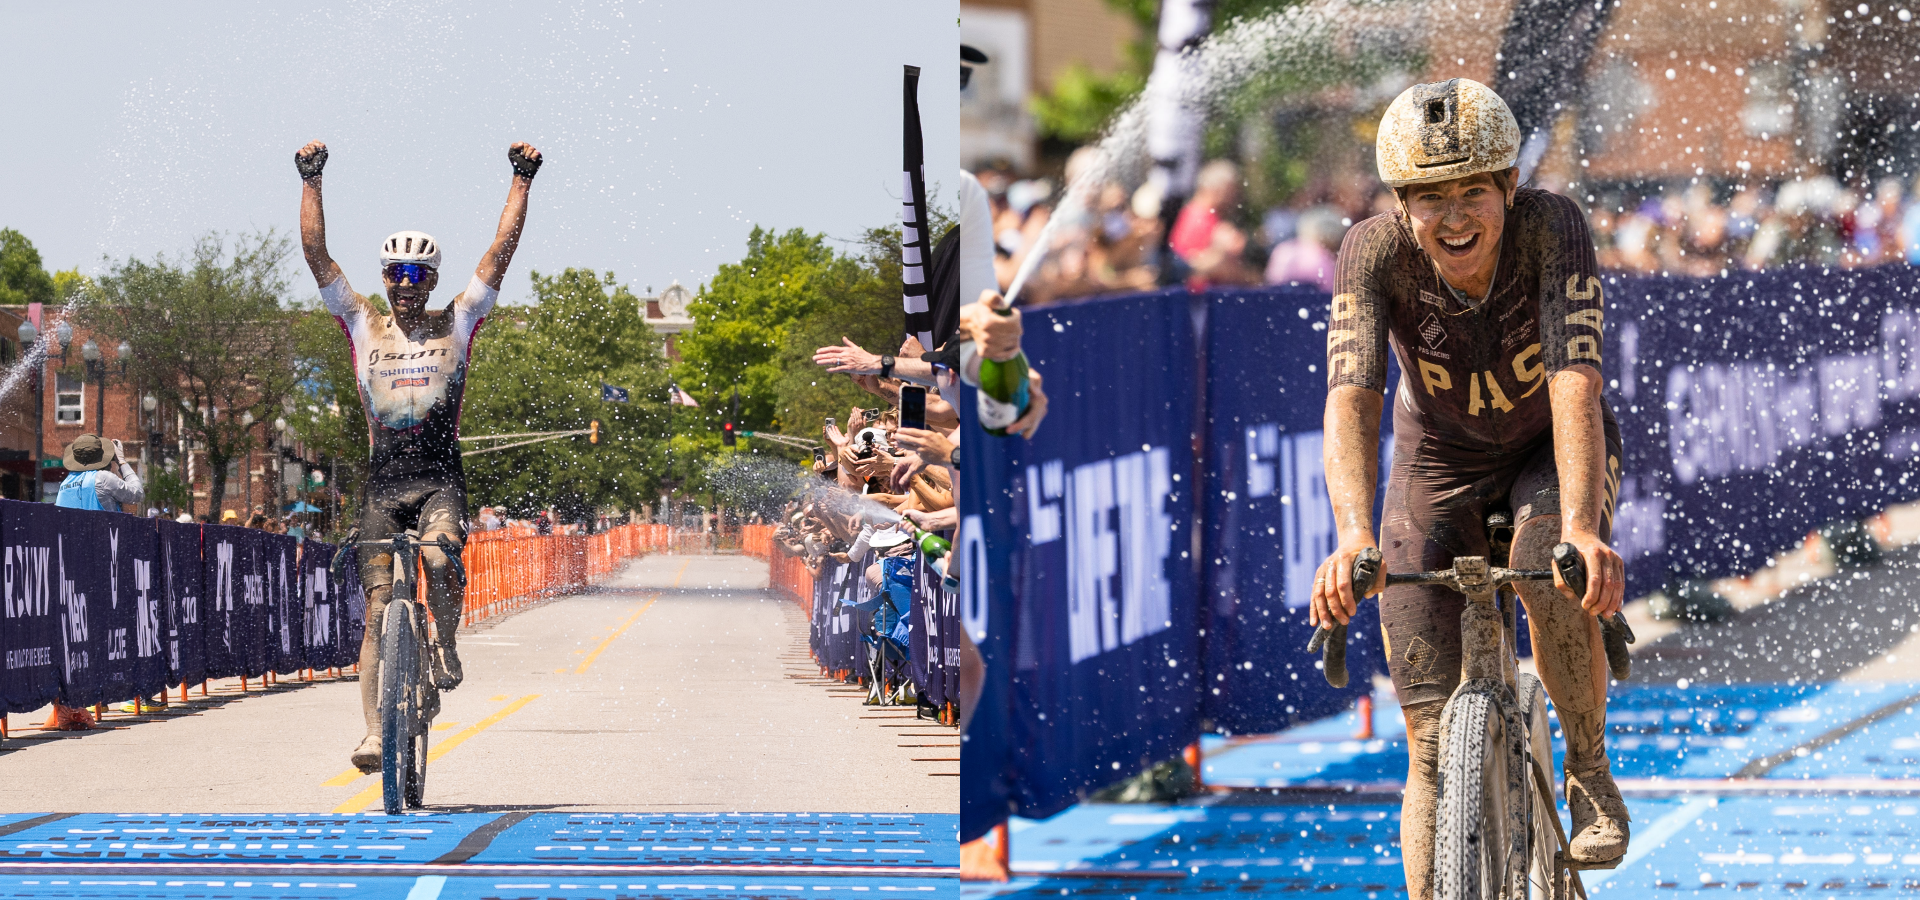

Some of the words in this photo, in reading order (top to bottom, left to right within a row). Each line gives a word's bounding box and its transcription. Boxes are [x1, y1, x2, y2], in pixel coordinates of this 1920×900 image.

[1565, 272, 1604, 366] PAS
[380, 365, 439, 378] SHIMANO
[381, 348, 450, 361] SCOTT
[1417, 343, 1546, 416] PAS
